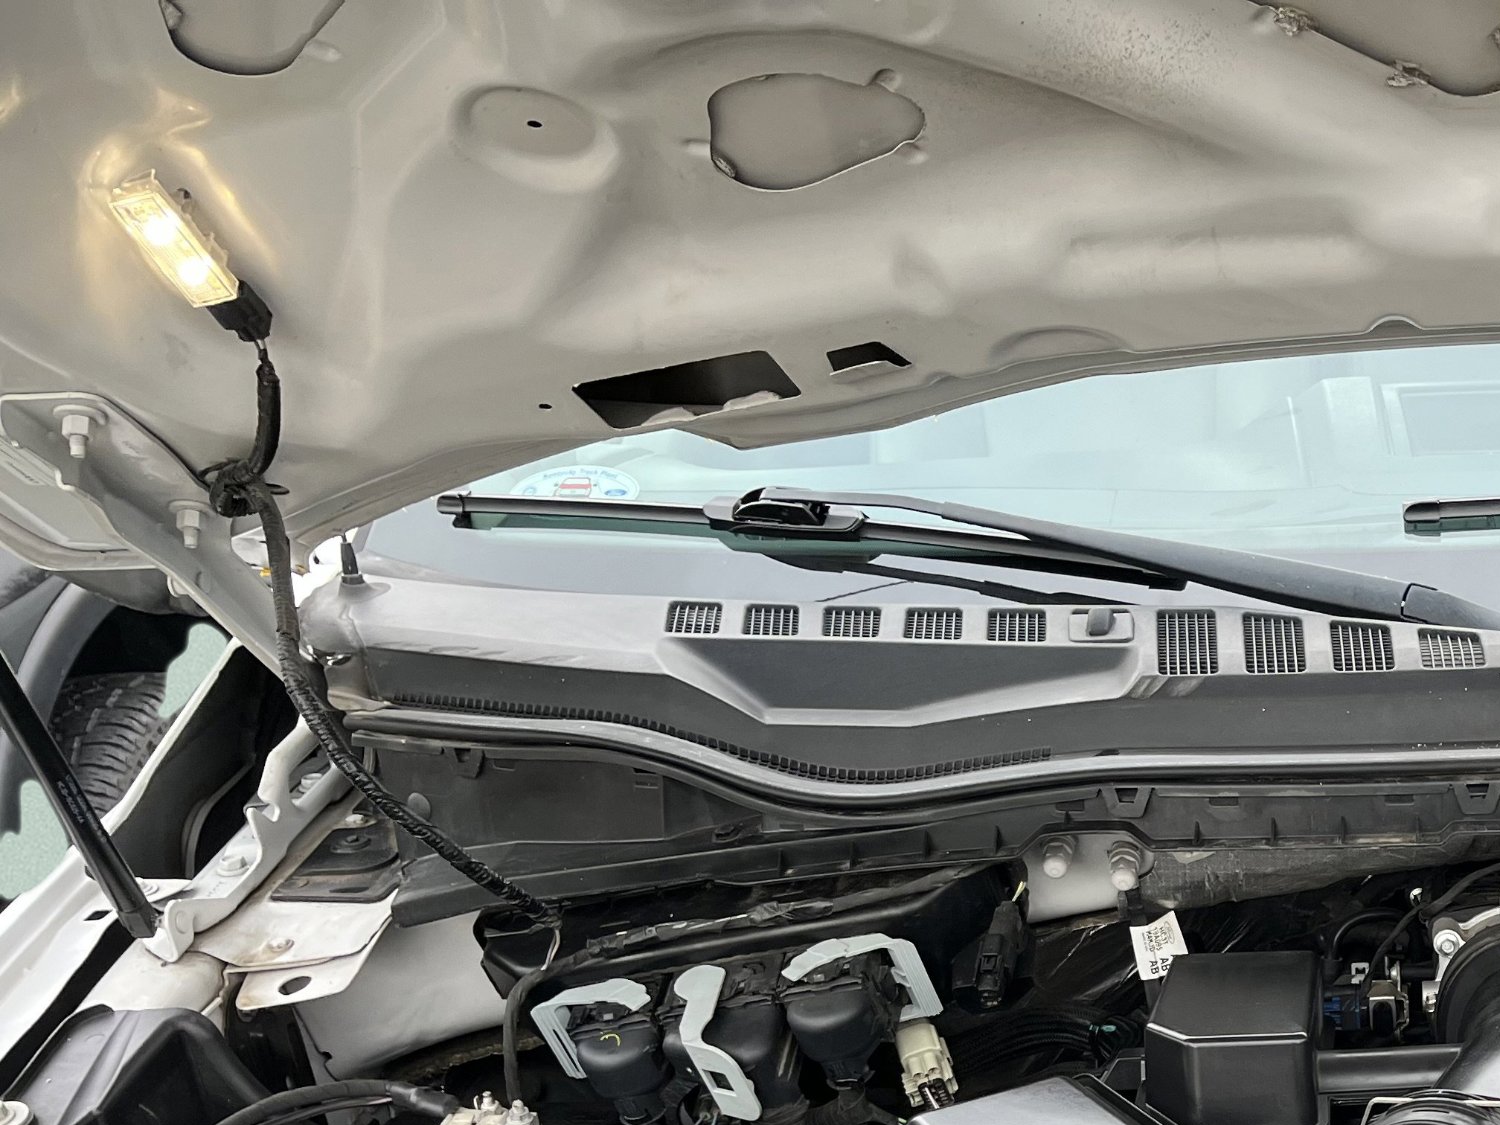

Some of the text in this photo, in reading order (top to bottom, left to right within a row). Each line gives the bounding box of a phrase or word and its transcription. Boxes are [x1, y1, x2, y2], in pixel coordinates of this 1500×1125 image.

[600, 470, 619, 479] Plant
[1149, 961, 1159, 974] AB
[1160, 958, 1170, 971] AB
